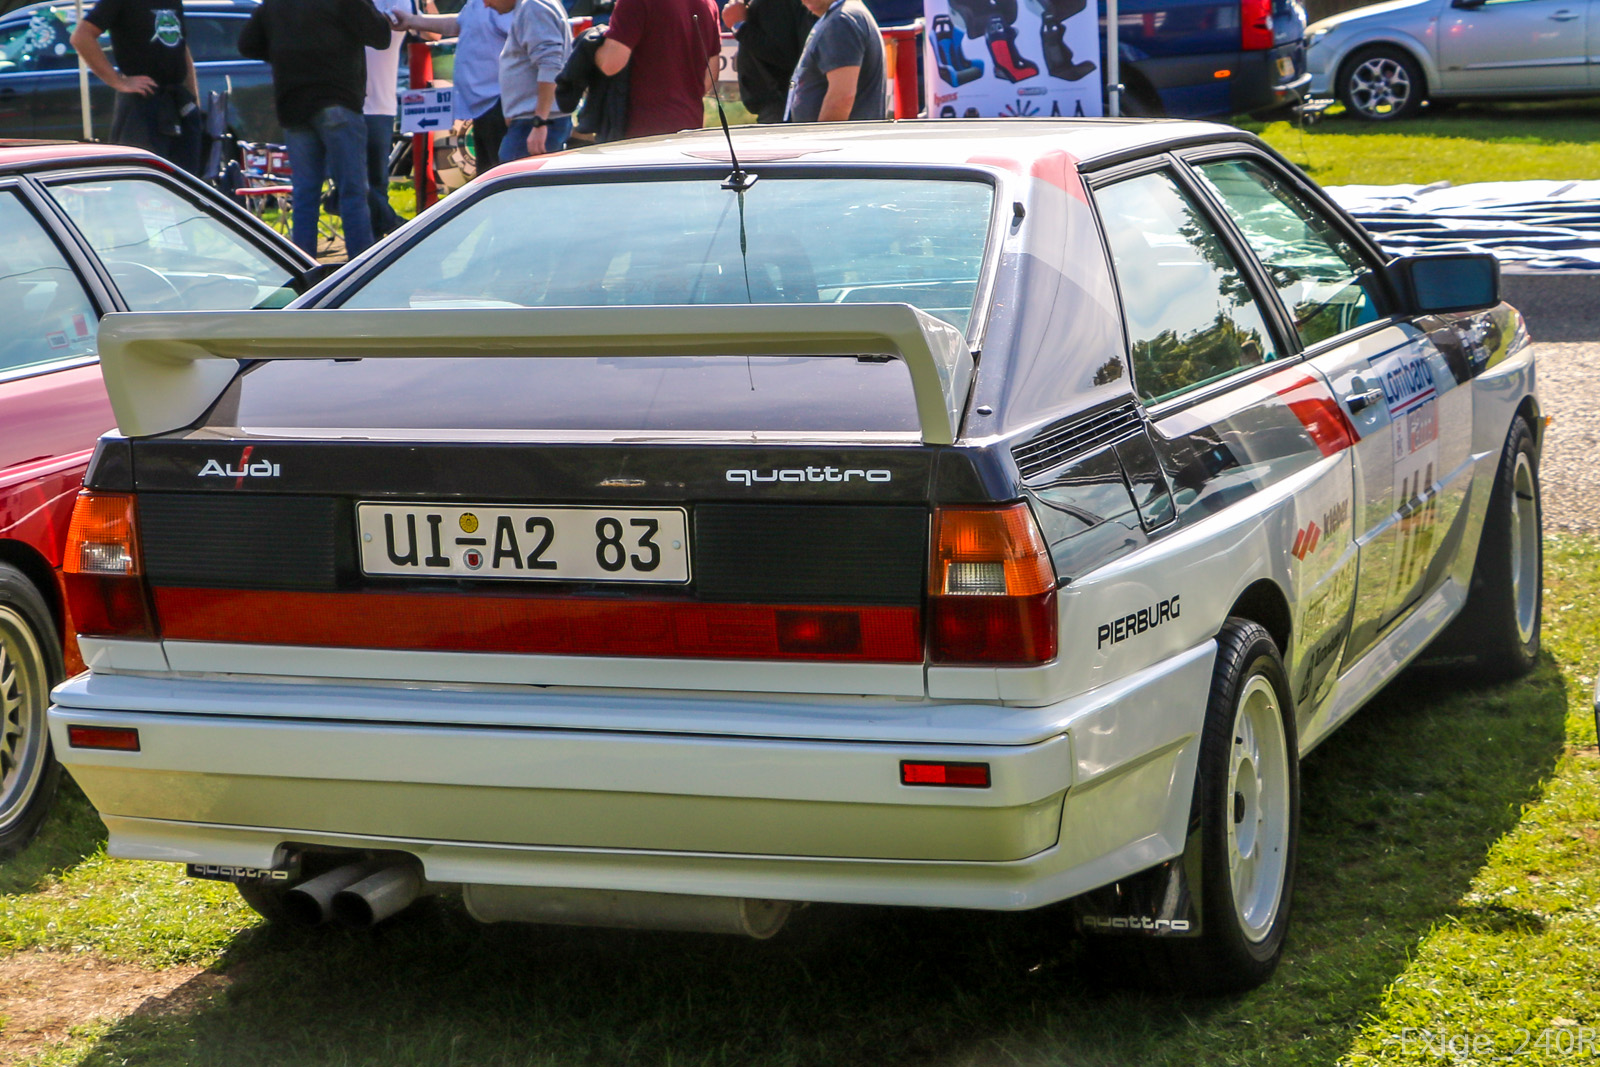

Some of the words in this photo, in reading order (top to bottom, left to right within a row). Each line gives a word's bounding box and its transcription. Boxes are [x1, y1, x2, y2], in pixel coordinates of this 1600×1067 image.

[197, 458, 281, 478] Audi
[725, 465, 892, 487] quattro
[594, 515, 663, 573] 83
[1097, 593, 1180, 650] PIERBURG
[194, 864, 288, 879] quattro
[1082, 915, 1190, 931] quattro
